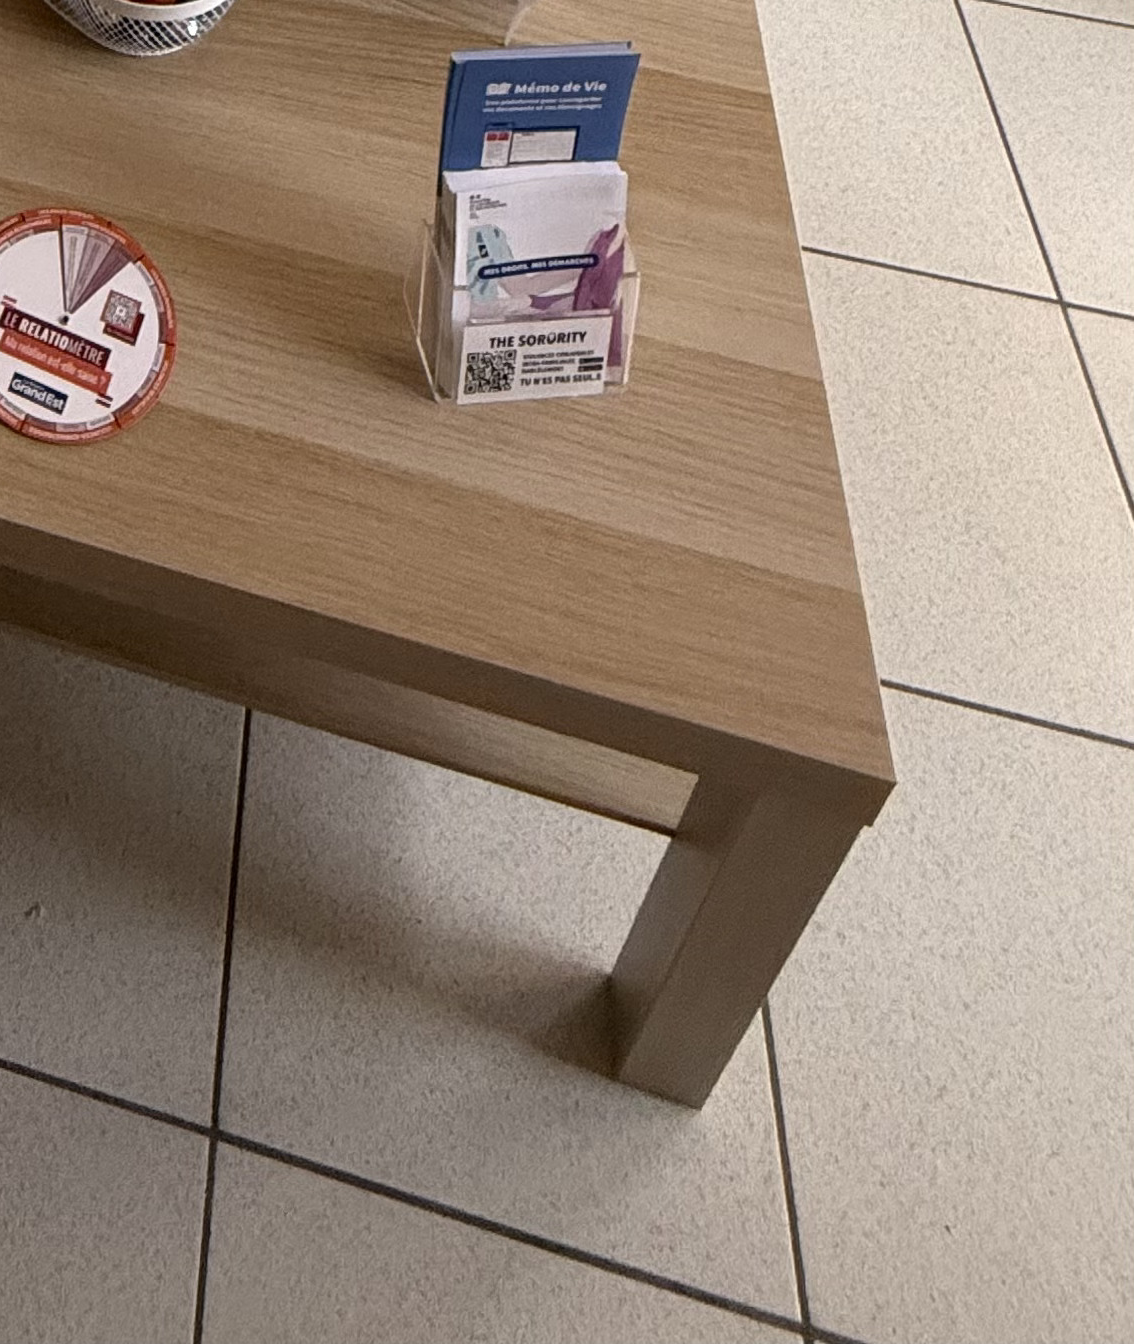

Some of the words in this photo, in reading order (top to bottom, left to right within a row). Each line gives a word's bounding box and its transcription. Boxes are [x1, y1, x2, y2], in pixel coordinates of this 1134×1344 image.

[513, 80, 560, 94] Mémo
[562, 81, 582, 93] de
[583, 80, 608, 92] Vie
[3, 311, 20, 330] LE
[18, 317, 106, 367] RELATIOMÈTRE
[489, 335, 516, 349] THE
[518, 331, 587, 348] SORORITY
[520, 378, 532, 386] TU
[554, 375, 571, 384] PAS
[11, 378, 47, 403] Grand
[46, 391, 65, 412] Est
